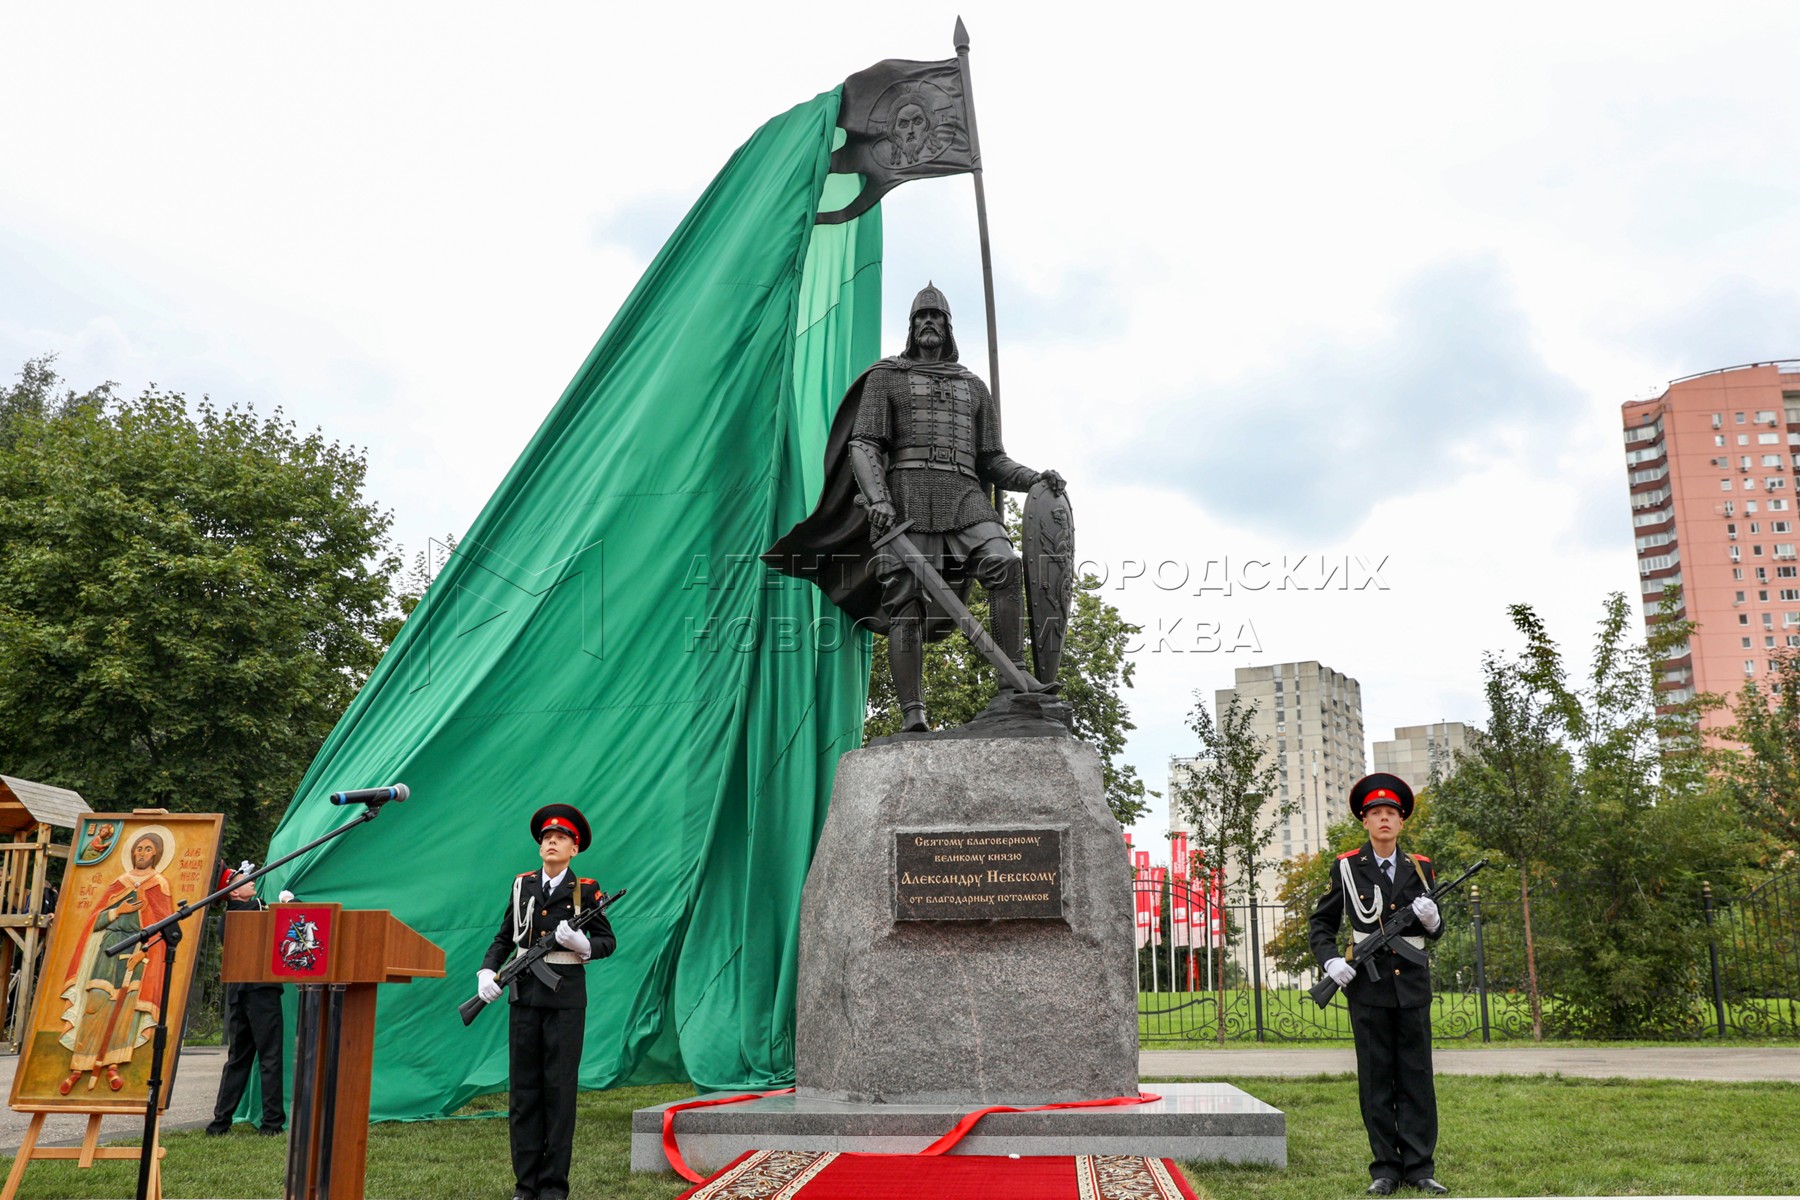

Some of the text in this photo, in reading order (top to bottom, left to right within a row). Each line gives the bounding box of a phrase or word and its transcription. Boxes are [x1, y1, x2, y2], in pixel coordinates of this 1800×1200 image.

[914, 836, 964, 848] Святому
[934, 854, 1022, 864] великому князю
[902, 870, 1056, 886] Александру Невскому
[926, 896, 994, 906] благодарных
[998, 892, 1050, 902] потомков
